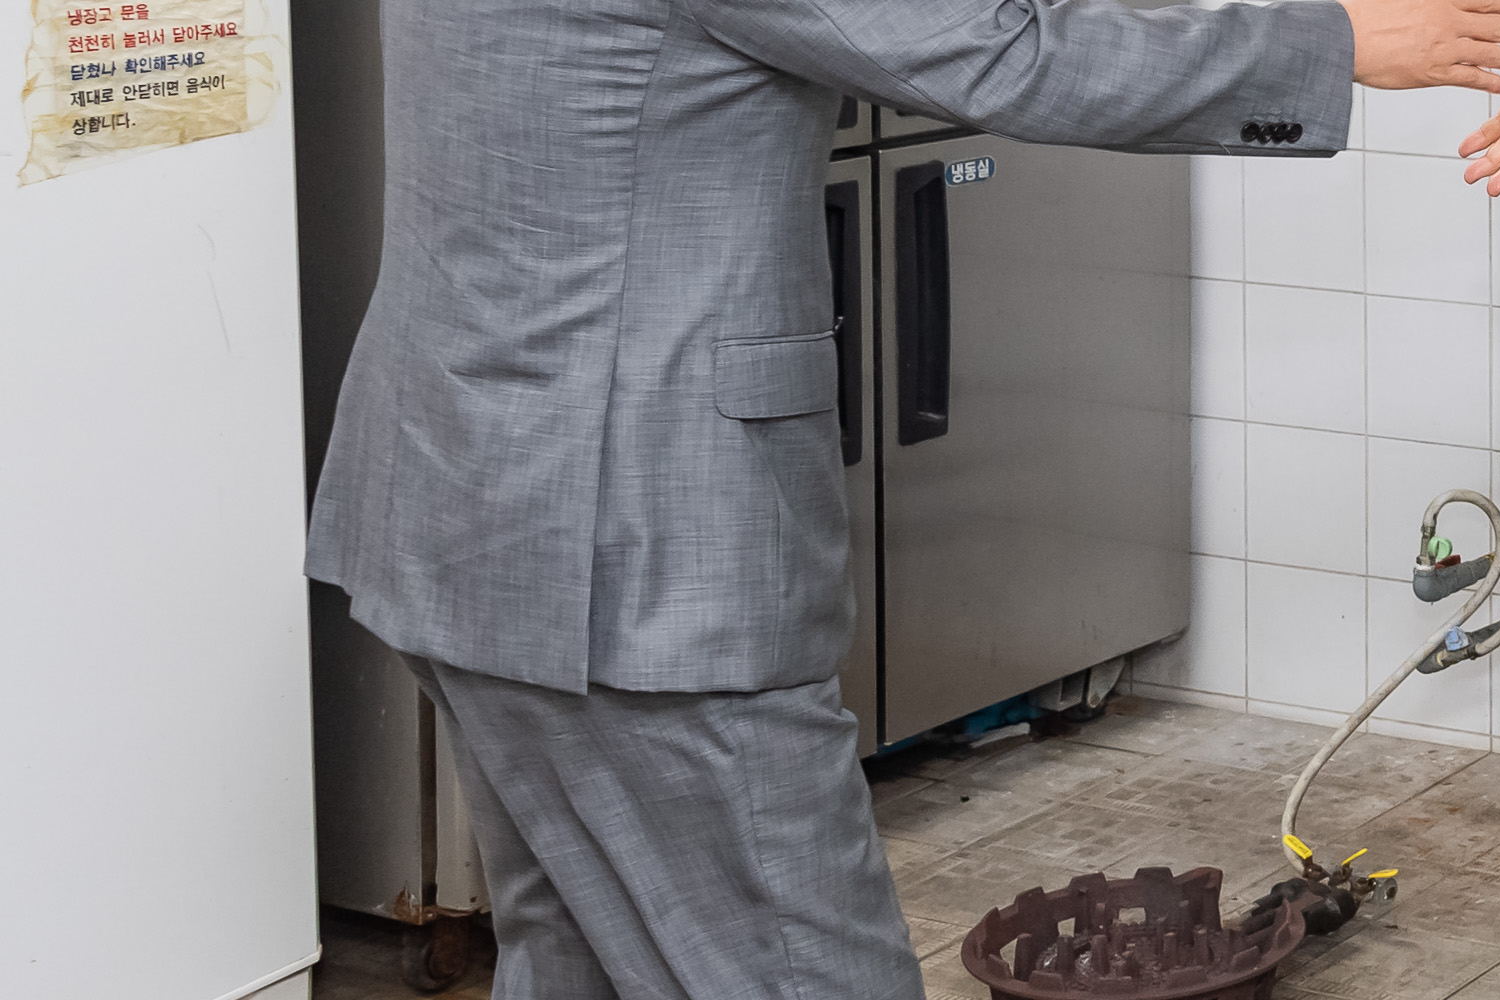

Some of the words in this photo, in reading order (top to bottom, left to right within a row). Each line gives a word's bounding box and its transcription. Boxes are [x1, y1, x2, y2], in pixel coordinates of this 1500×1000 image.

[67, 7, 113, 26] 냉장고
[120, 3, 149, 21] 문을
[68, 33, 115, 53] 천천히
[122, 28, 165, 48] 눌러서
[172, 21, 238, 43] 닫아주세요
[124, 51, 206, 74] 확인해주세요
[70, 87, 114, 107] 제대로
[122, 80, 179, 101] 안닫히면
[186, 74, 225, 94] 음식이
[71, 112, 136, 136] 상합니다.
[951, 158, 990, 184] 냉동실
